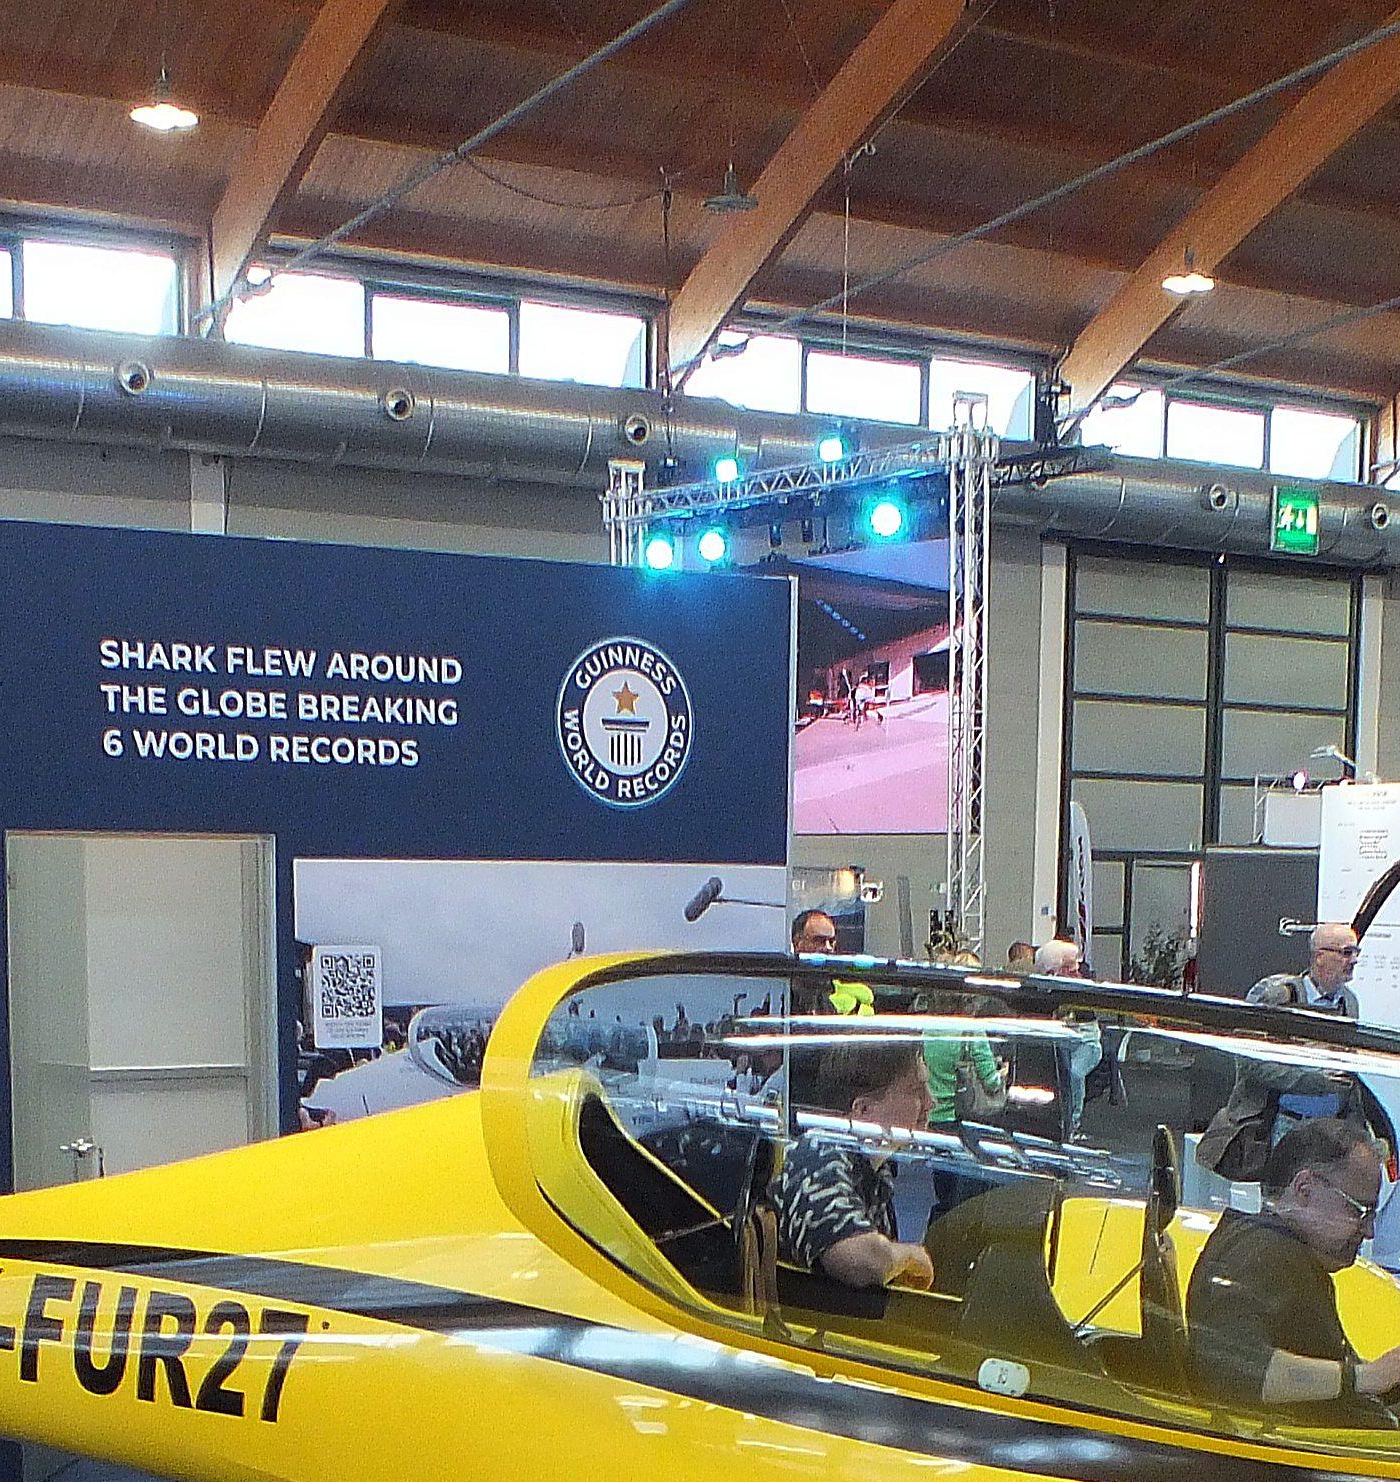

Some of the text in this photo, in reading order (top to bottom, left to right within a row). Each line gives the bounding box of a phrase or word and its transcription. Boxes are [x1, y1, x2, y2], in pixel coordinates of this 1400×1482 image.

[100, 640, 463, 685] SHARK FLEW AROUND
[575, 645, 677, 695] GUINNESS
[100, 684, 458, 726] THE GLOBE BREAKING
[103, 729, 420, 767] 6 WORLD RECORDS
[564, 709, 686, 798] WORLD RECORDS
